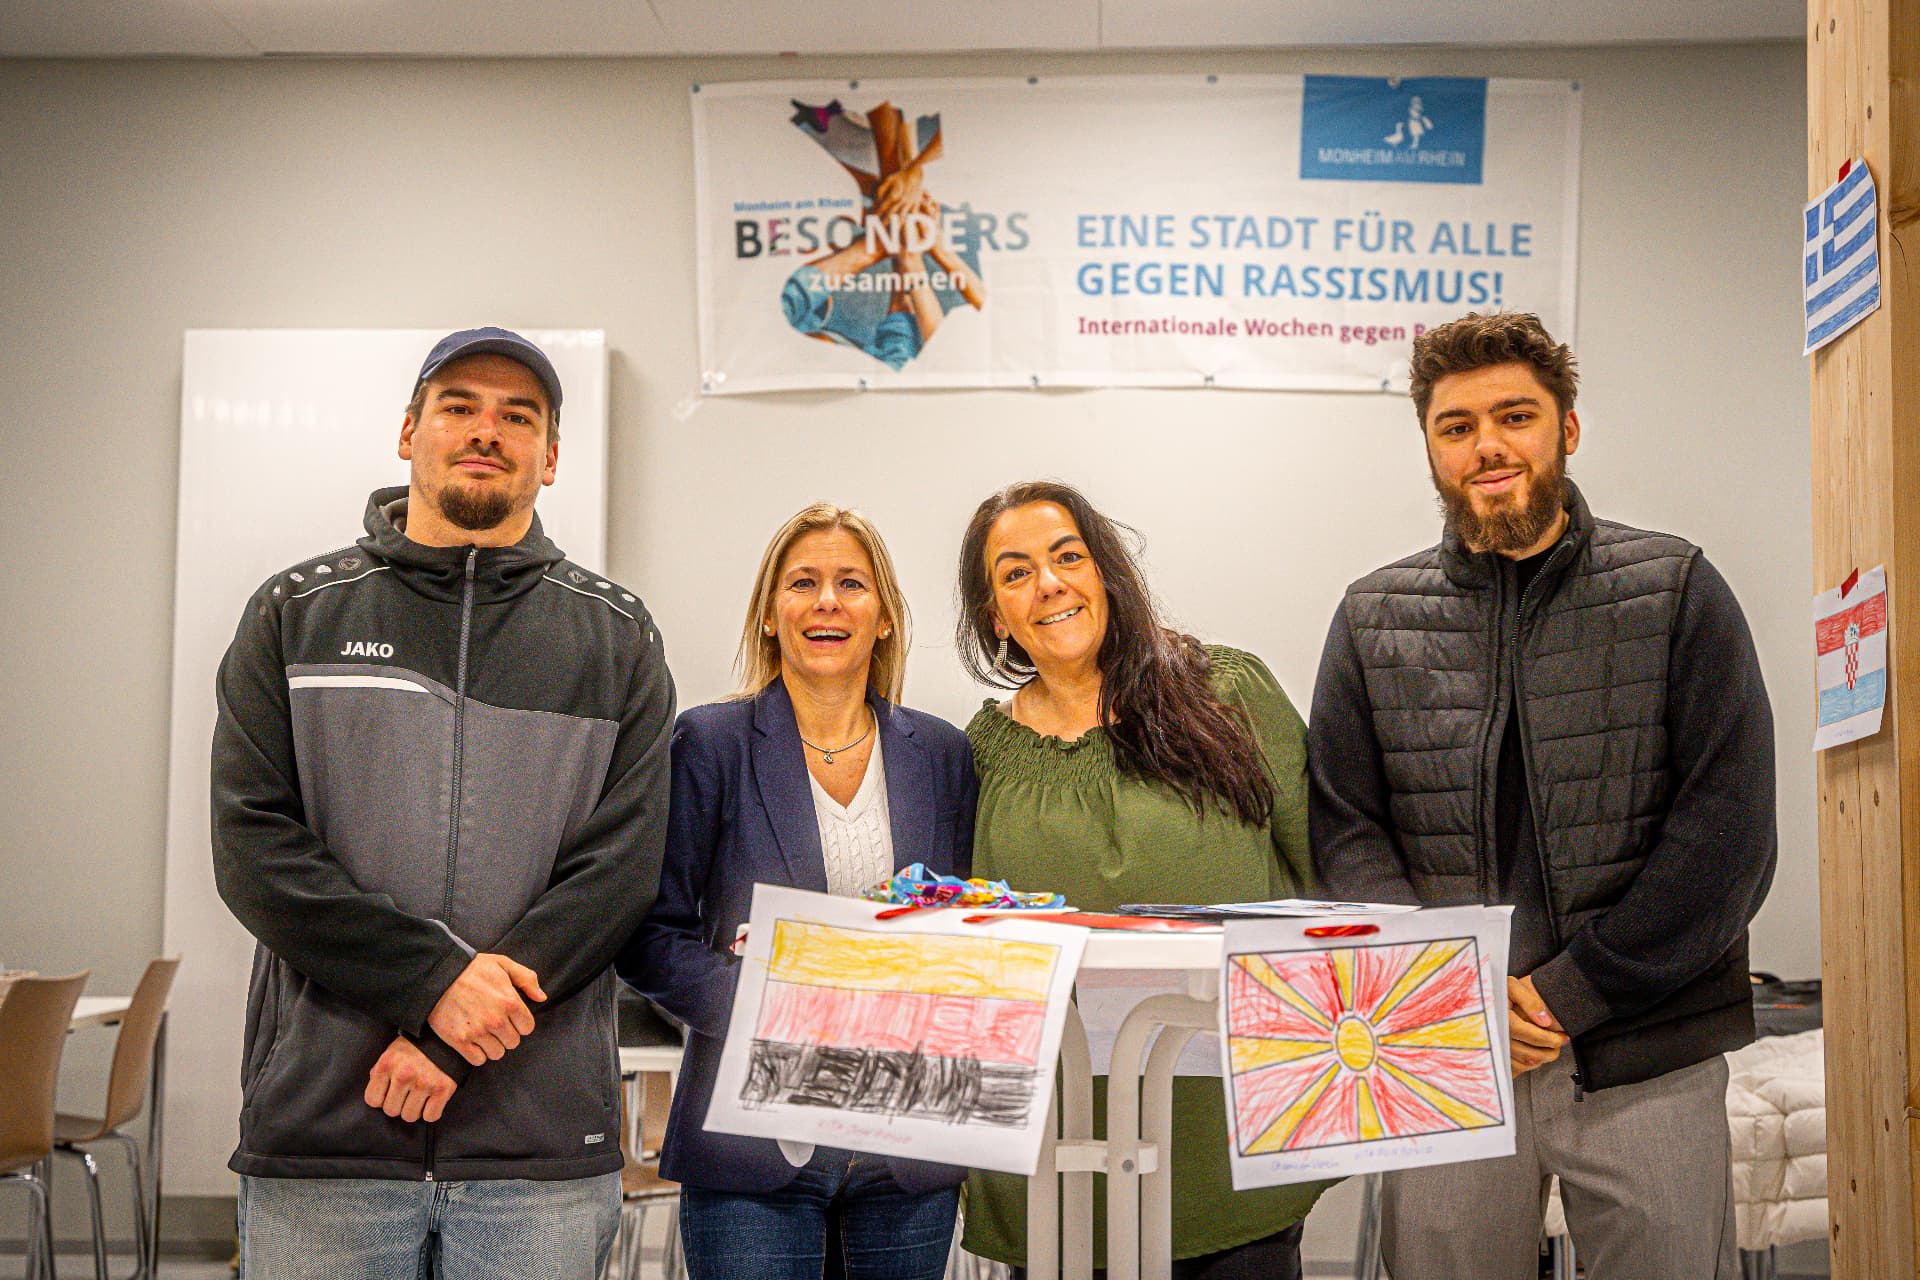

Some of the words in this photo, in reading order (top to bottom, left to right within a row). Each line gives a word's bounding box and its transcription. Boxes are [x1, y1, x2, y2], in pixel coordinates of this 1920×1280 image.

[734, 211, 1029, 259] BESONDERS
[1077, 214, 1176, 248] EINE
[1189, 215, 1319, 250] STADT
[1333, 210, 1416, 254] FÜR
[1428, 221, 1532, 258] ALLE
[808, 271, 967, 293] zusammen
[1076, 262, 1224, 297] GEGEN
[1243, 264, 1504, 305] RASSISMUS!
[1078, 316, 1238, 336] Internationale
[1244, 318, 1333, 337] Wochen
[1339, 324, 1406, 344] gegen
[340, 641, 395, 658] JAKO
